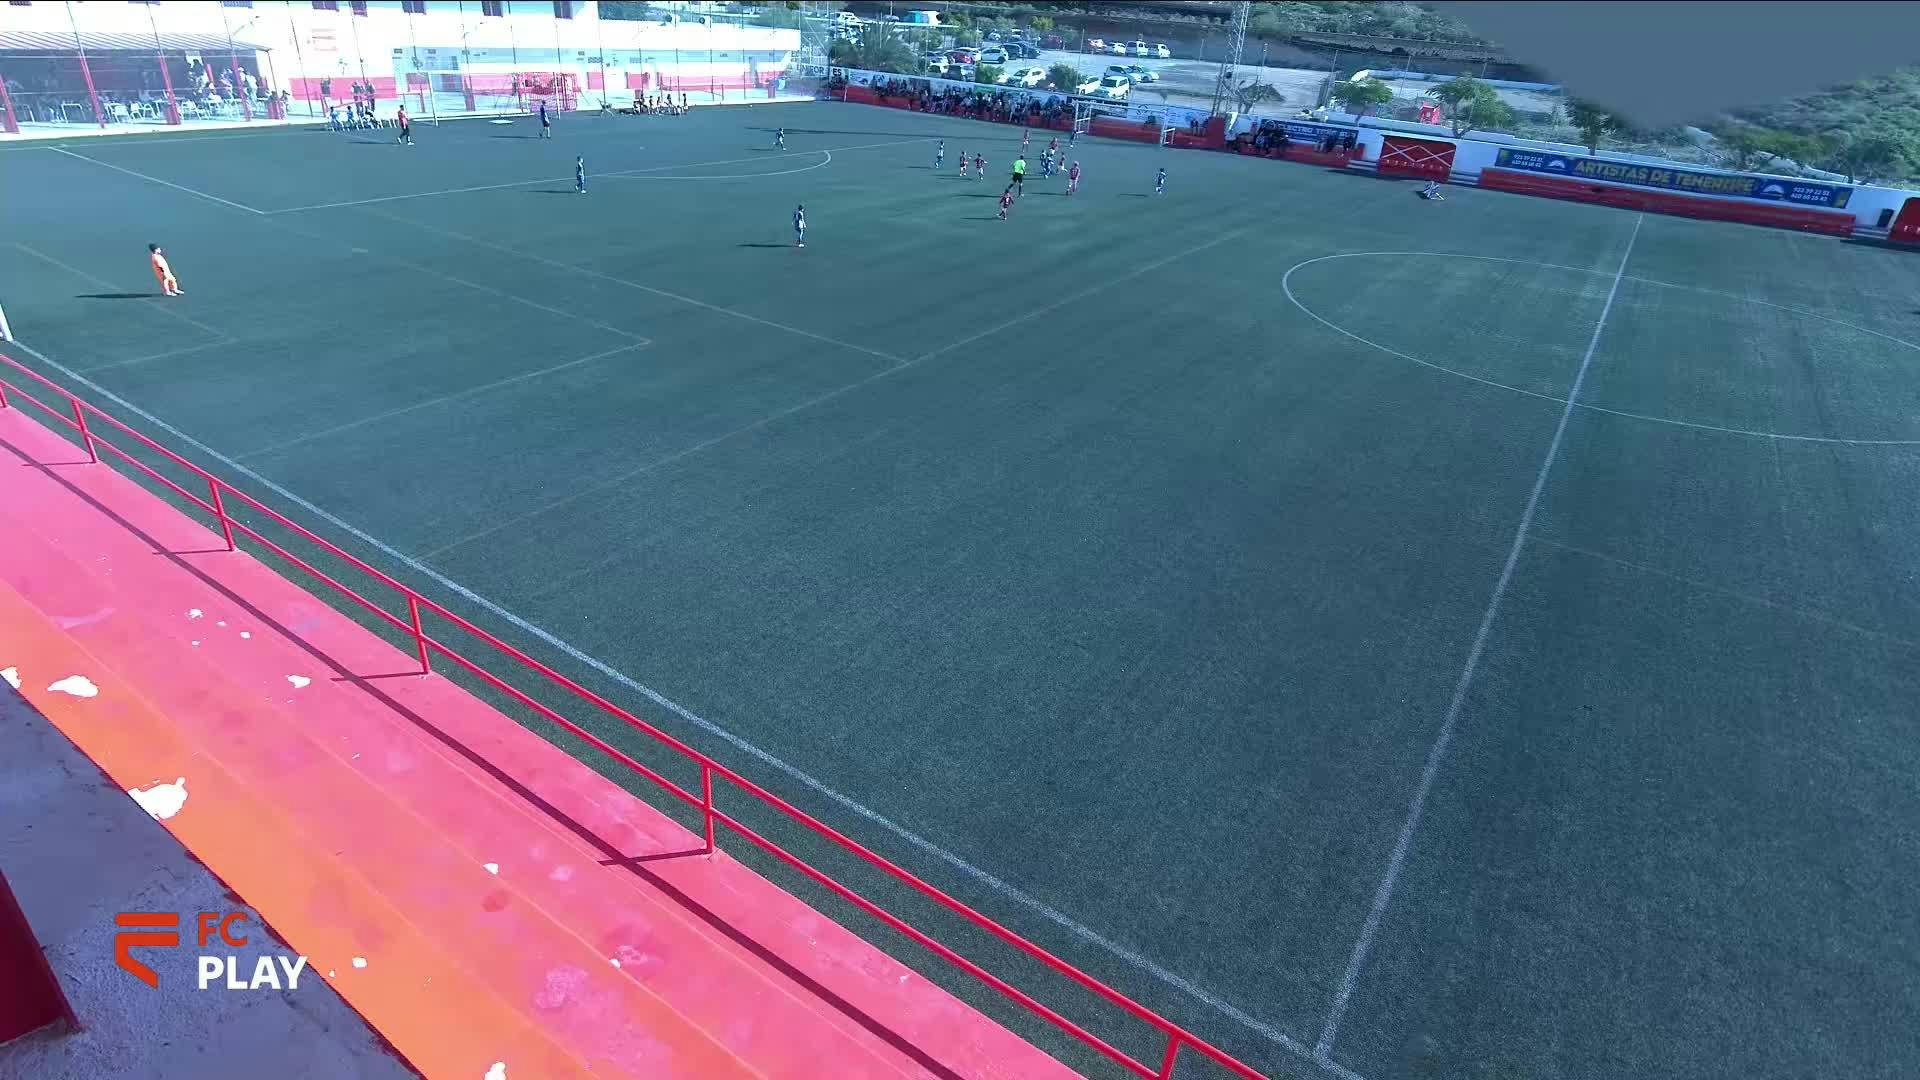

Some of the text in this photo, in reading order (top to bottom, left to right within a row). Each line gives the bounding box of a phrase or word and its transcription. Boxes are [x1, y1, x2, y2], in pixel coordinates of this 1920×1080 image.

[1575, 160, 1648, 179] ARTISTAS
[1648, 169, 1672, 184] DE
[1675, 172, 1755, 192] TENERIFE
